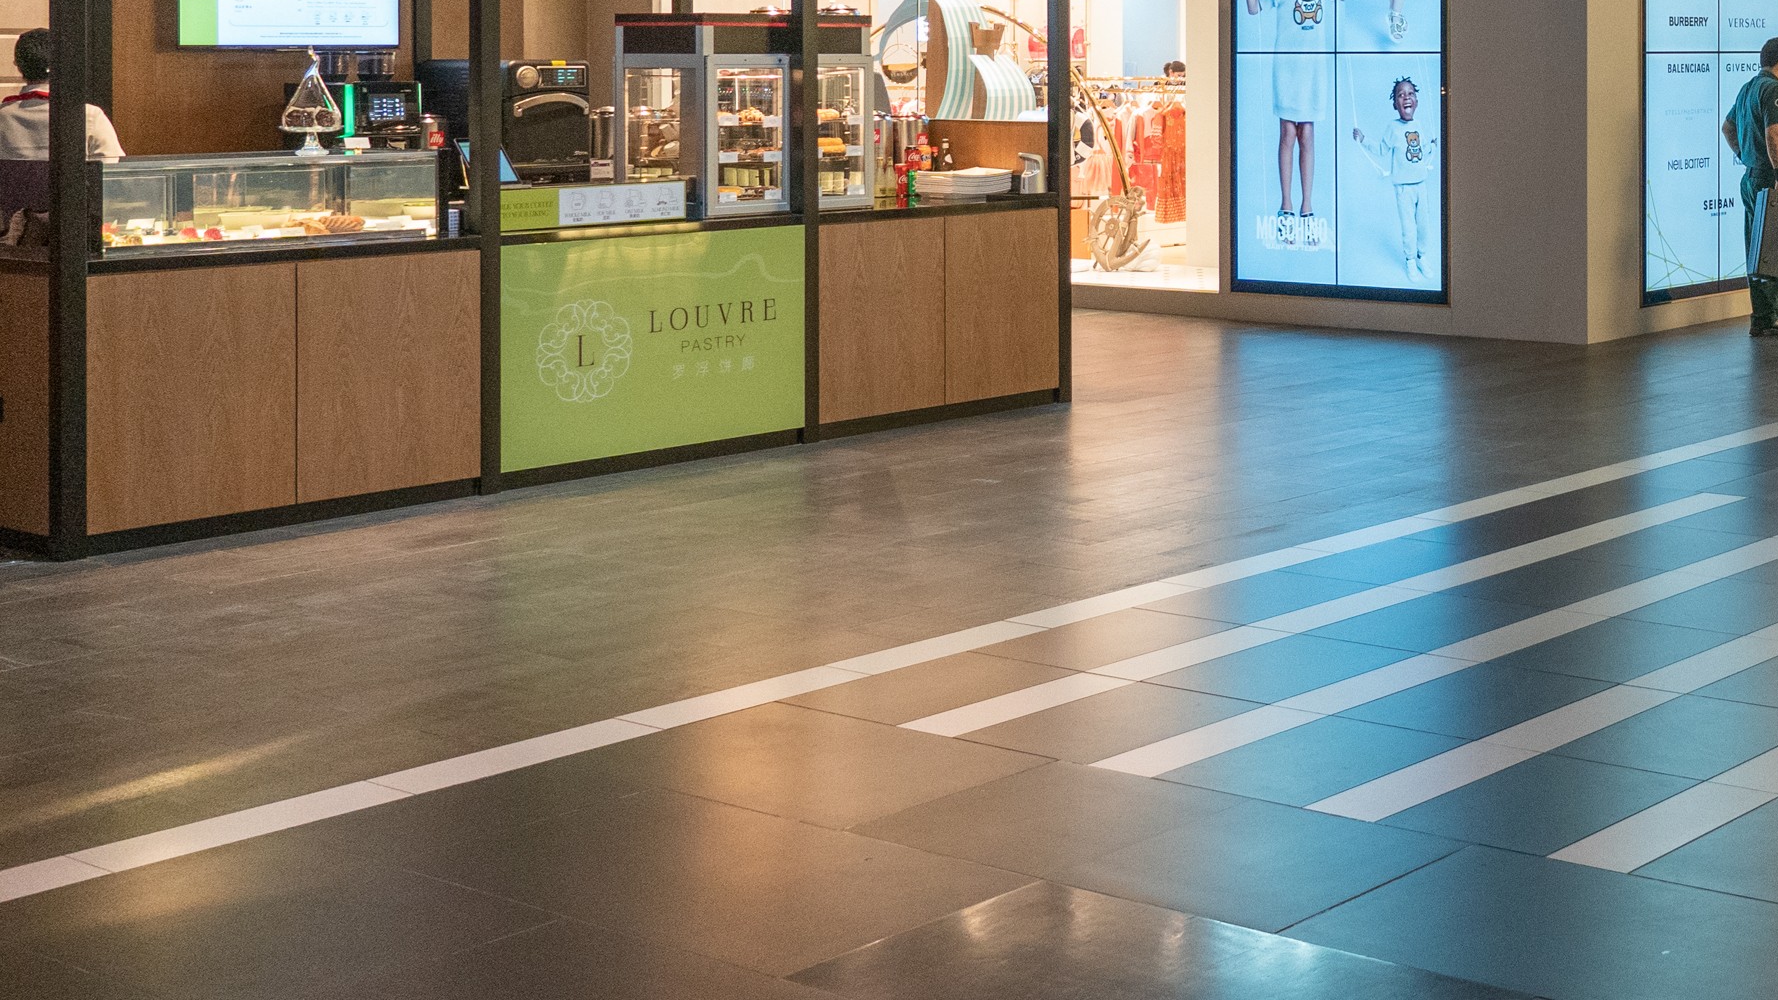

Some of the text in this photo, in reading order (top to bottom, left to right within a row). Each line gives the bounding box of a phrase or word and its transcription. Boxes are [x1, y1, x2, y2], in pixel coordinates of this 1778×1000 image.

[1668, 16, 1709, 27] BURBERRY
[1728, 18, 1766, 29] VERSACE
[1667, 63, 1710, 73] BALENCIAGA
[430, 134, 444, 146] illy
[1703, 198, 1735, 211] SEIBAN
[1256, 214, 1328, 242] MOSCHINO
[648, 297, 777, 333] LOUVRE
[681, 333, 746, 353] PASTRY
[577, 334, 595, 367] L
